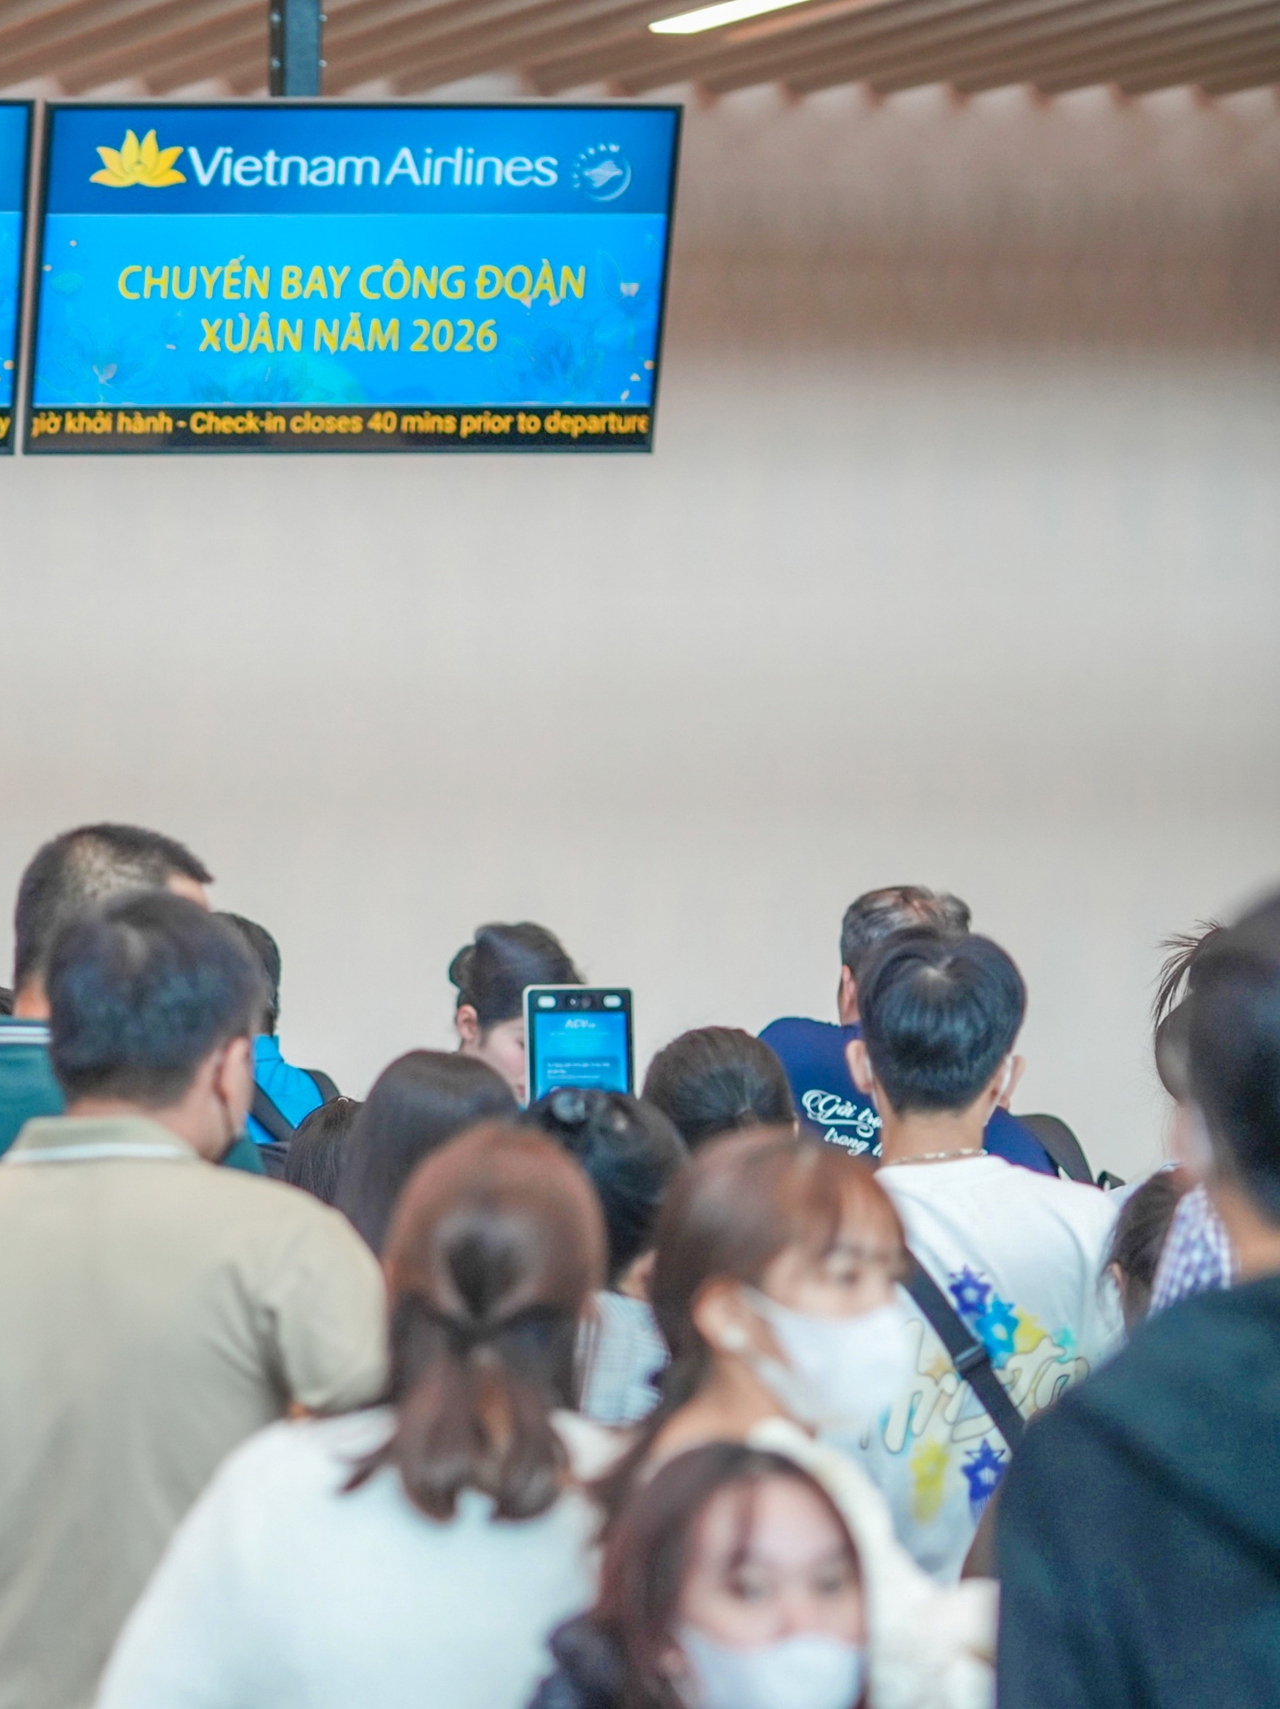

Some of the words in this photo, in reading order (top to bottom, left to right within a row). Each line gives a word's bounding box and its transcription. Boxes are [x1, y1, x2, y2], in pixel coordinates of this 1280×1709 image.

[187, 146, 380, 187] Vietnam
[384, 145, 559, 187] Airlines
[118, 255, 271, 301] CHUYẾN
[280, 265, 351, 300] BAY
[358, 258, 466, 300] CÔNG
[313, 311, 401, 353] NĂM
[409, 318, 499, 353] 2026
[116, 411, 174, 434] hành
[189, 410, 287, 434] Check-in
[289, 410, 364, 434] closes
[366, 410, 398, 434] 40
[400, 411, 458, 434] mins
[459, 411, 515, 439] prior
[517, 411, 542, 434] to
